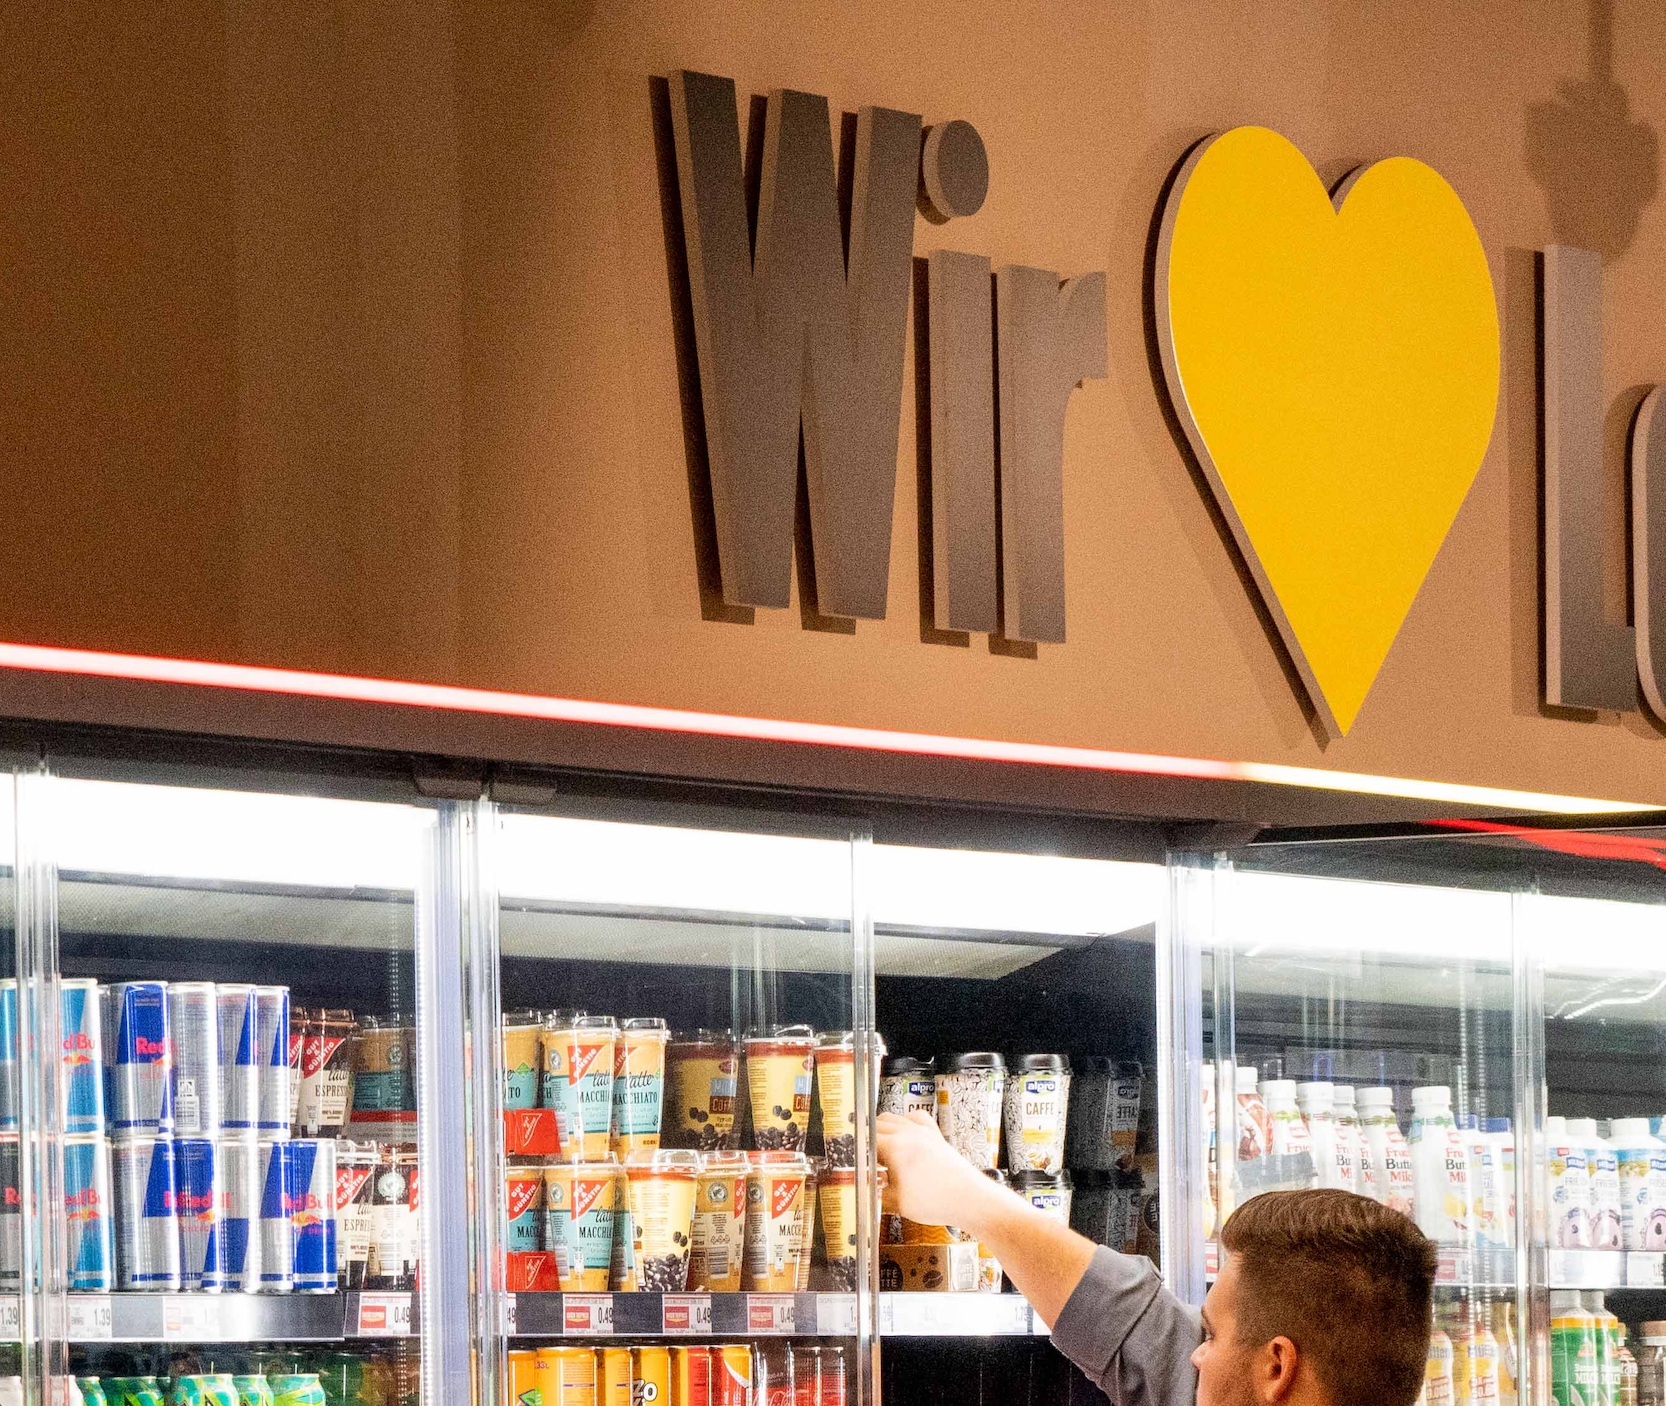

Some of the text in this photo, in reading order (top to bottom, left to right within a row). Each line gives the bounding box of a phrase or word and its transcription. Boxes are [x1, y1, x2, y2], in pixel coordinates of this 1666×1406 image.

[667, 70, 1108, 644] Wir
[911, 1082, 935, 1093] alpro
[1026, 1080, 1055, 1092] alpro
[1033, 1196, 1060, 1208] alpro
[0, 1306, 18, 1324] 1.39
[94, 1306, 111, 1326] 1.39
[394, 1306, 411, 1325] 0.49
[598, 1307, 613, 1324] 0.49
[696, 1307, 712, 1324] 0.49
[780, 1307, 795, 1324] 0.49
